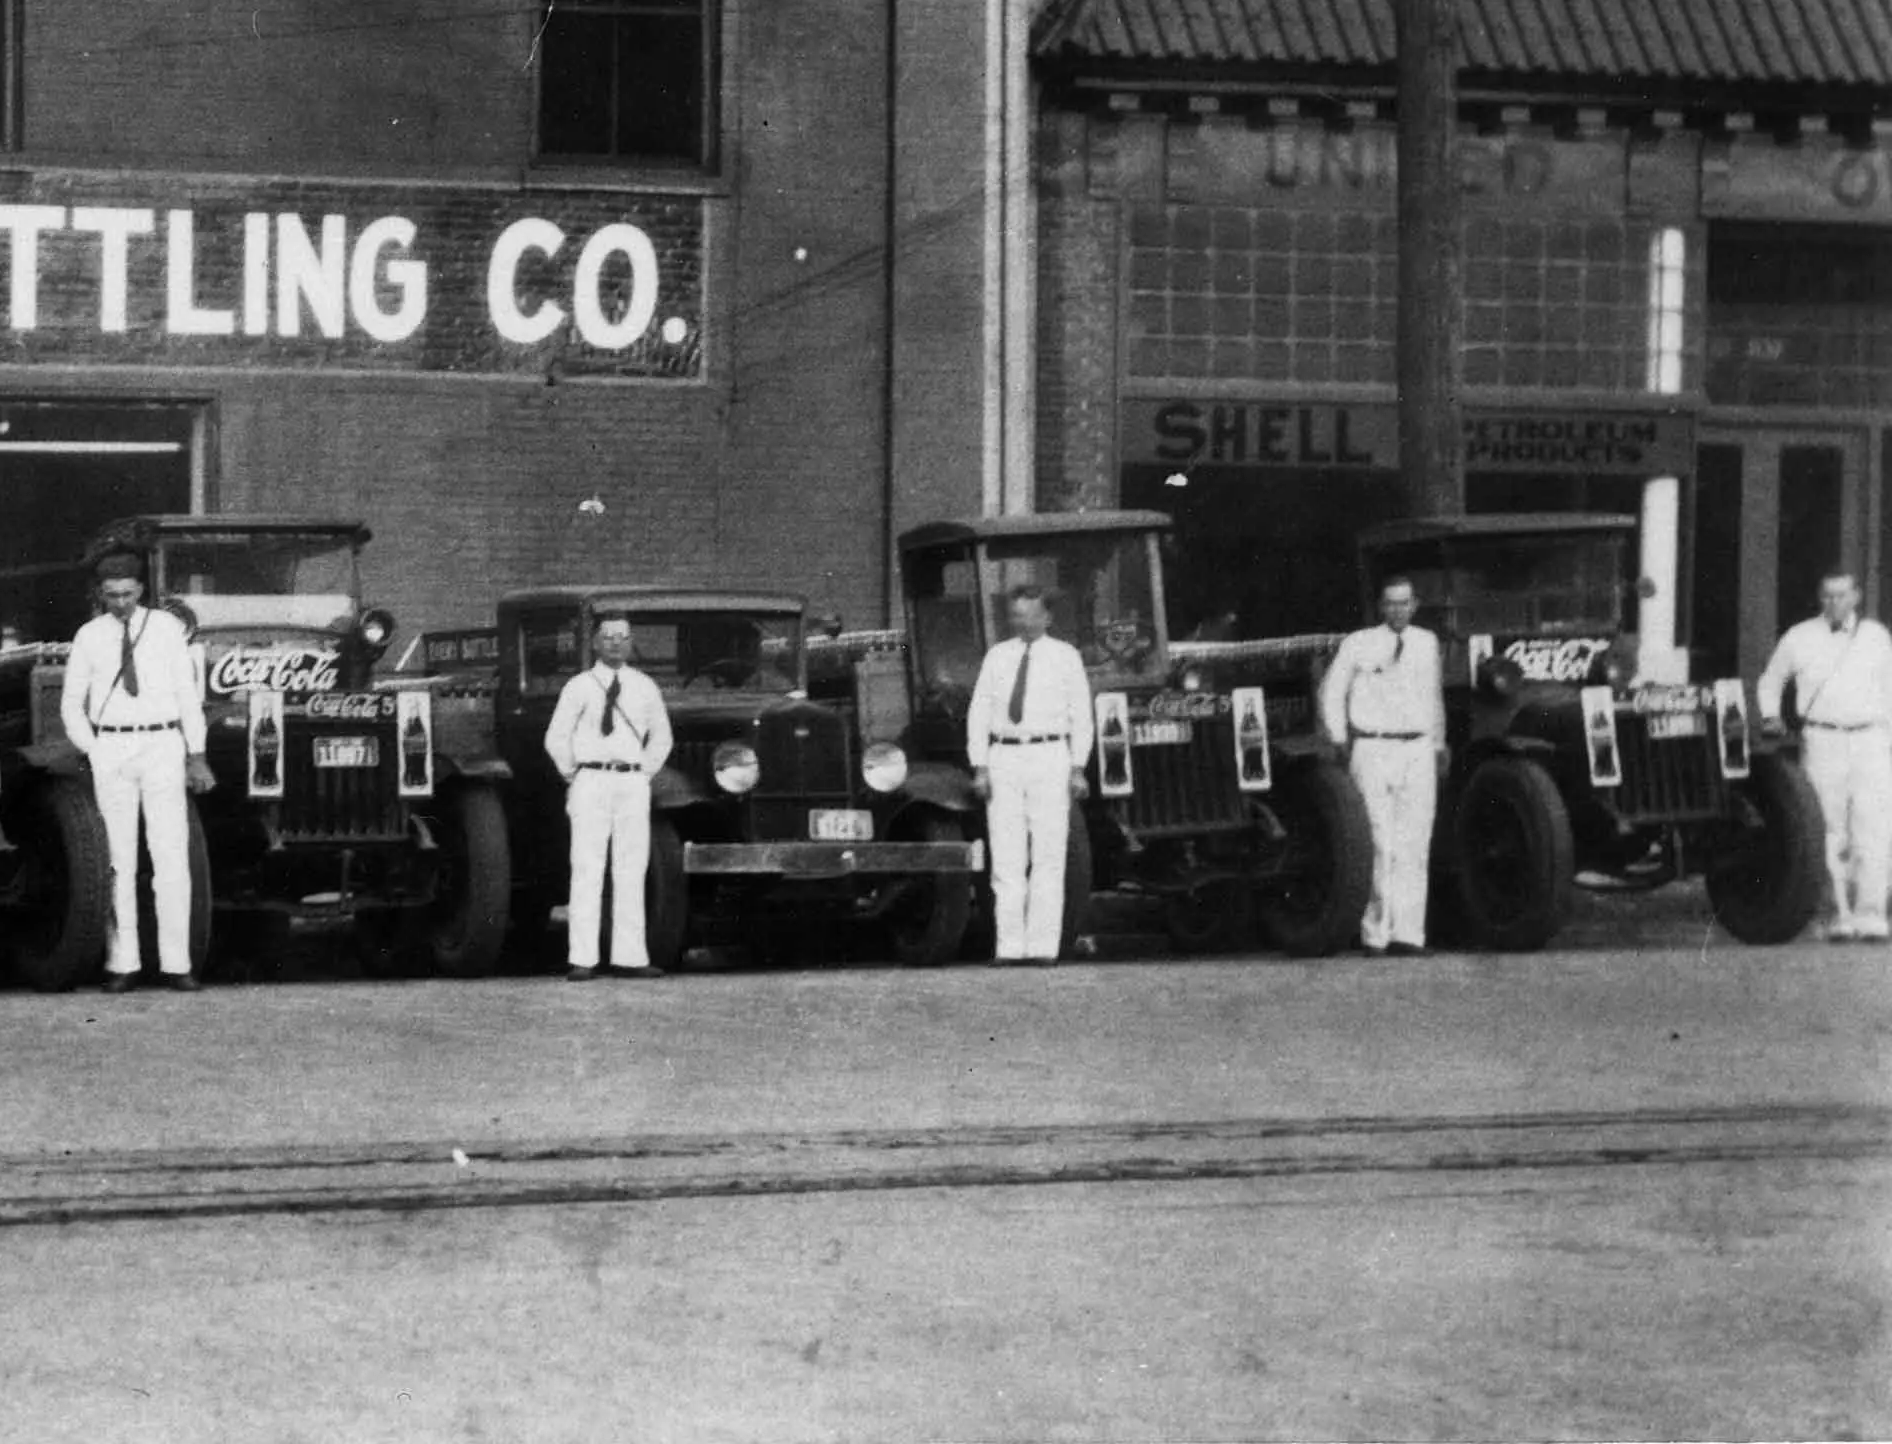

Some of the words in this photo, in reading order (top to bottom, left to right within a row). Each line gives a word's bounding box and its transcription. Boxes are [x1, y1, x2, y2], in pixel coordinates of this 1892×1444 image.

[486, 217, 688, 351] CO.
[1155, 406, 1373, 463] SHELL
[210, 647, 342, 694] Coca-Cola
